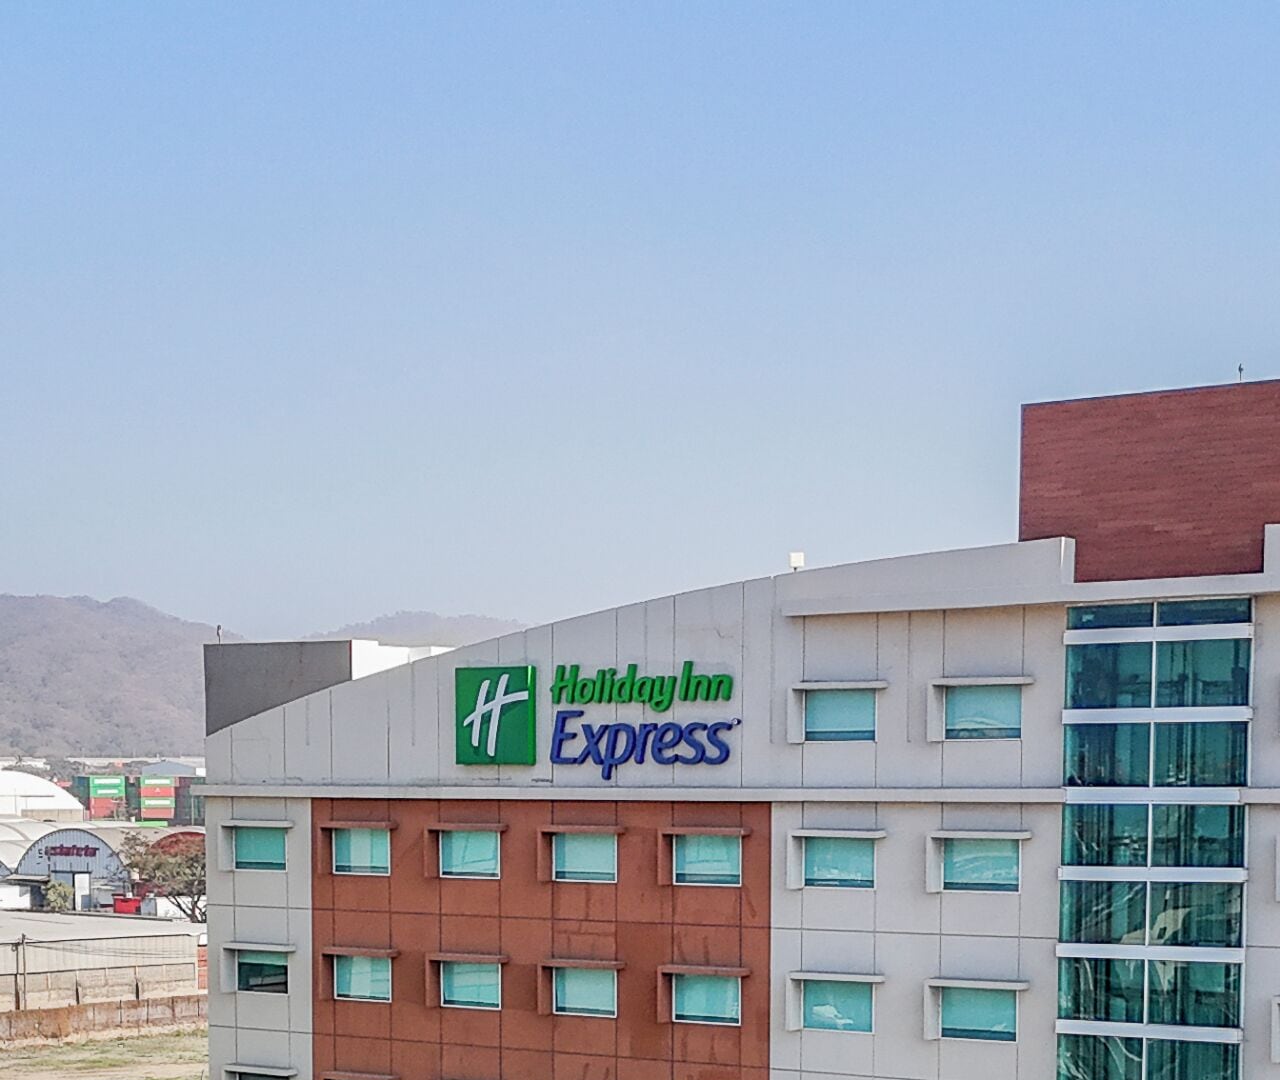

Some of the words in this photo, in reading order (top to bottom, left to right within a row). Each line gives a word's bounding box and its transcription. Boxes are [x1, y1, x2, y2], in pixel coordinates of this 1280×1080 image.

[463, 673, 528, 758] H
[550, 663, 677, 713] Holiday
[679, 661, 734, 702] Inn
[550, 710, 732, 781] Express
